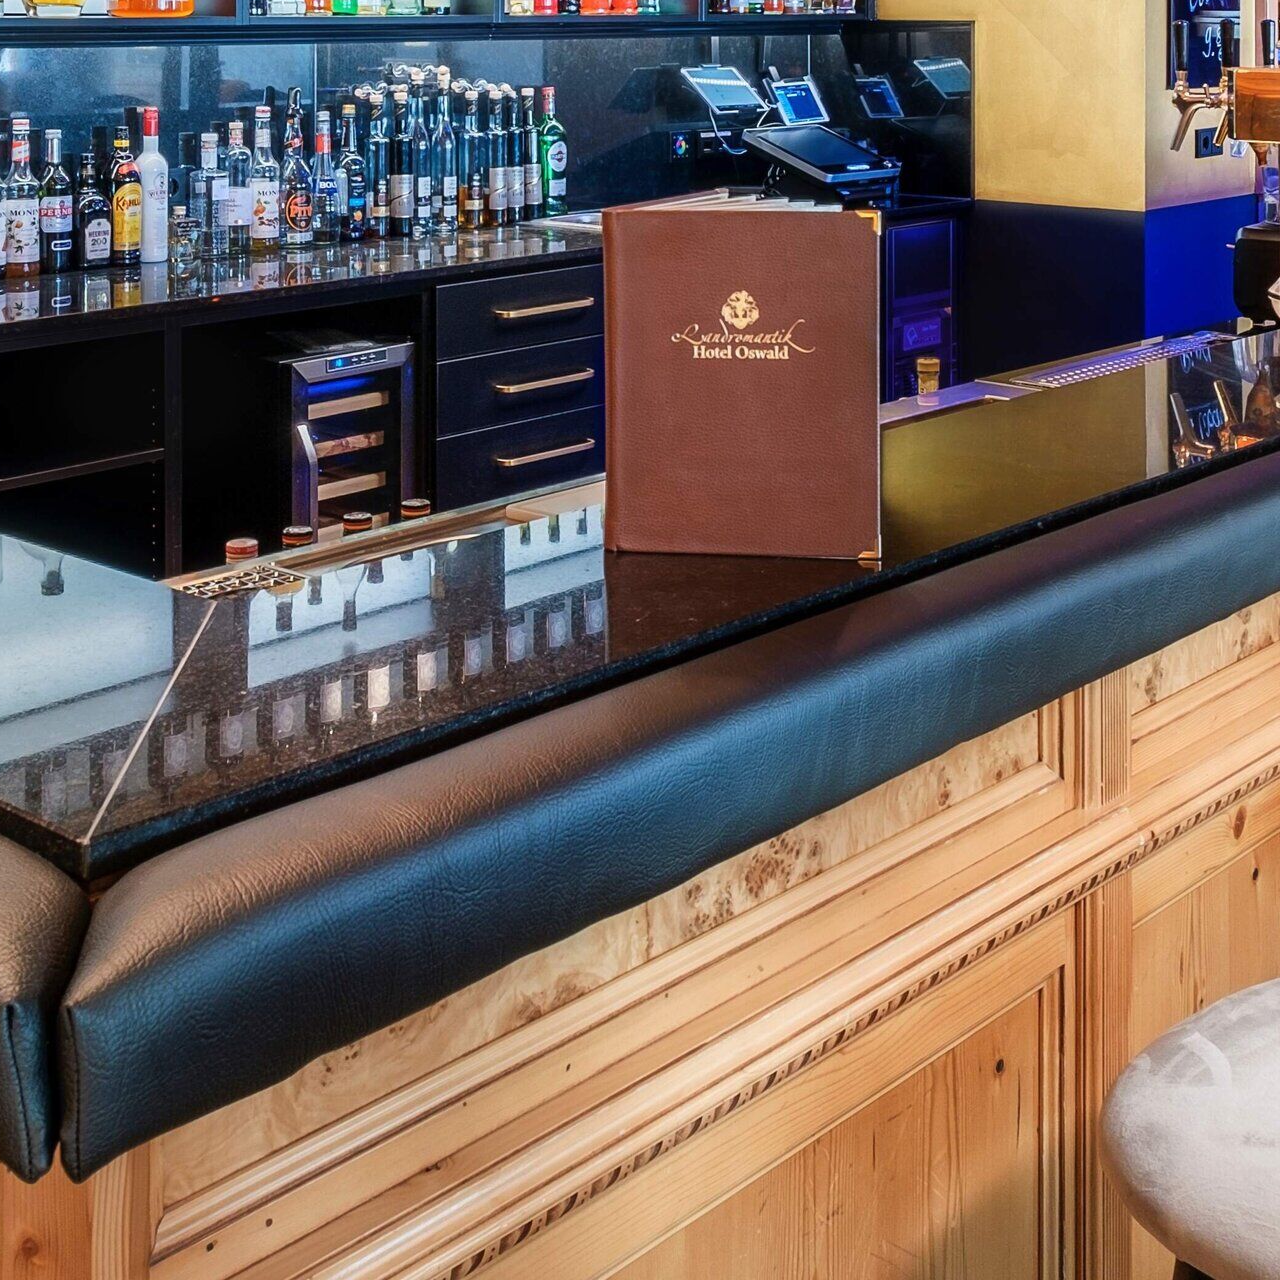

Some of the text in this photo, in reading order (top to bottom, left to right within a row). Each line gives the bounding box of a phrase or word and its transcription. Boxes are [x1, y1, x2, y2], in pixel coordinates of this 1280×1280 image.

[91, 238, 107, 246] 200
[671, 318, 816, 353] Landromantik
[692, 345, 790, 360] Hotel Oswald
